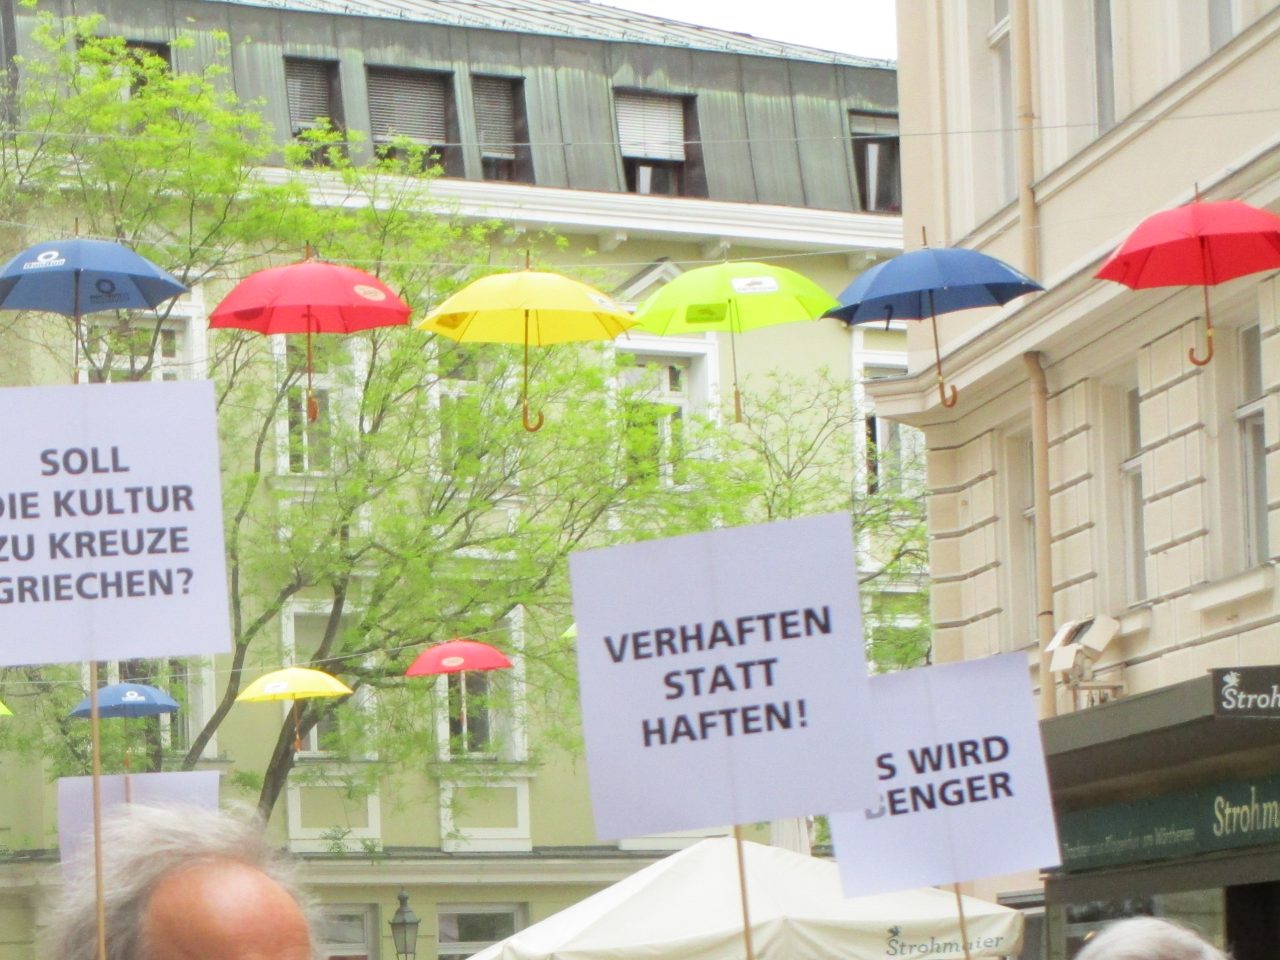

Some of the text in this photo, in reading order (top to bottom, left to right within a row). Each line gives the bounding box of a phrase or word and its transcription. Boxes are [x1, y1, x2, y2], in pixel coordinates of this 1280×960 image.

[39, 445, 130, 477] SOLL
[53, 484, 195, 518] KULTUR
[48, 526, 190, 560] KREUZE
[603, 605, 832, 664] VERHAFTEN
[663, 657, 779, 701] STATT
[641, 698, 808, 748] HAFTEN!
[907, 735, 1011, 775] WIRD
